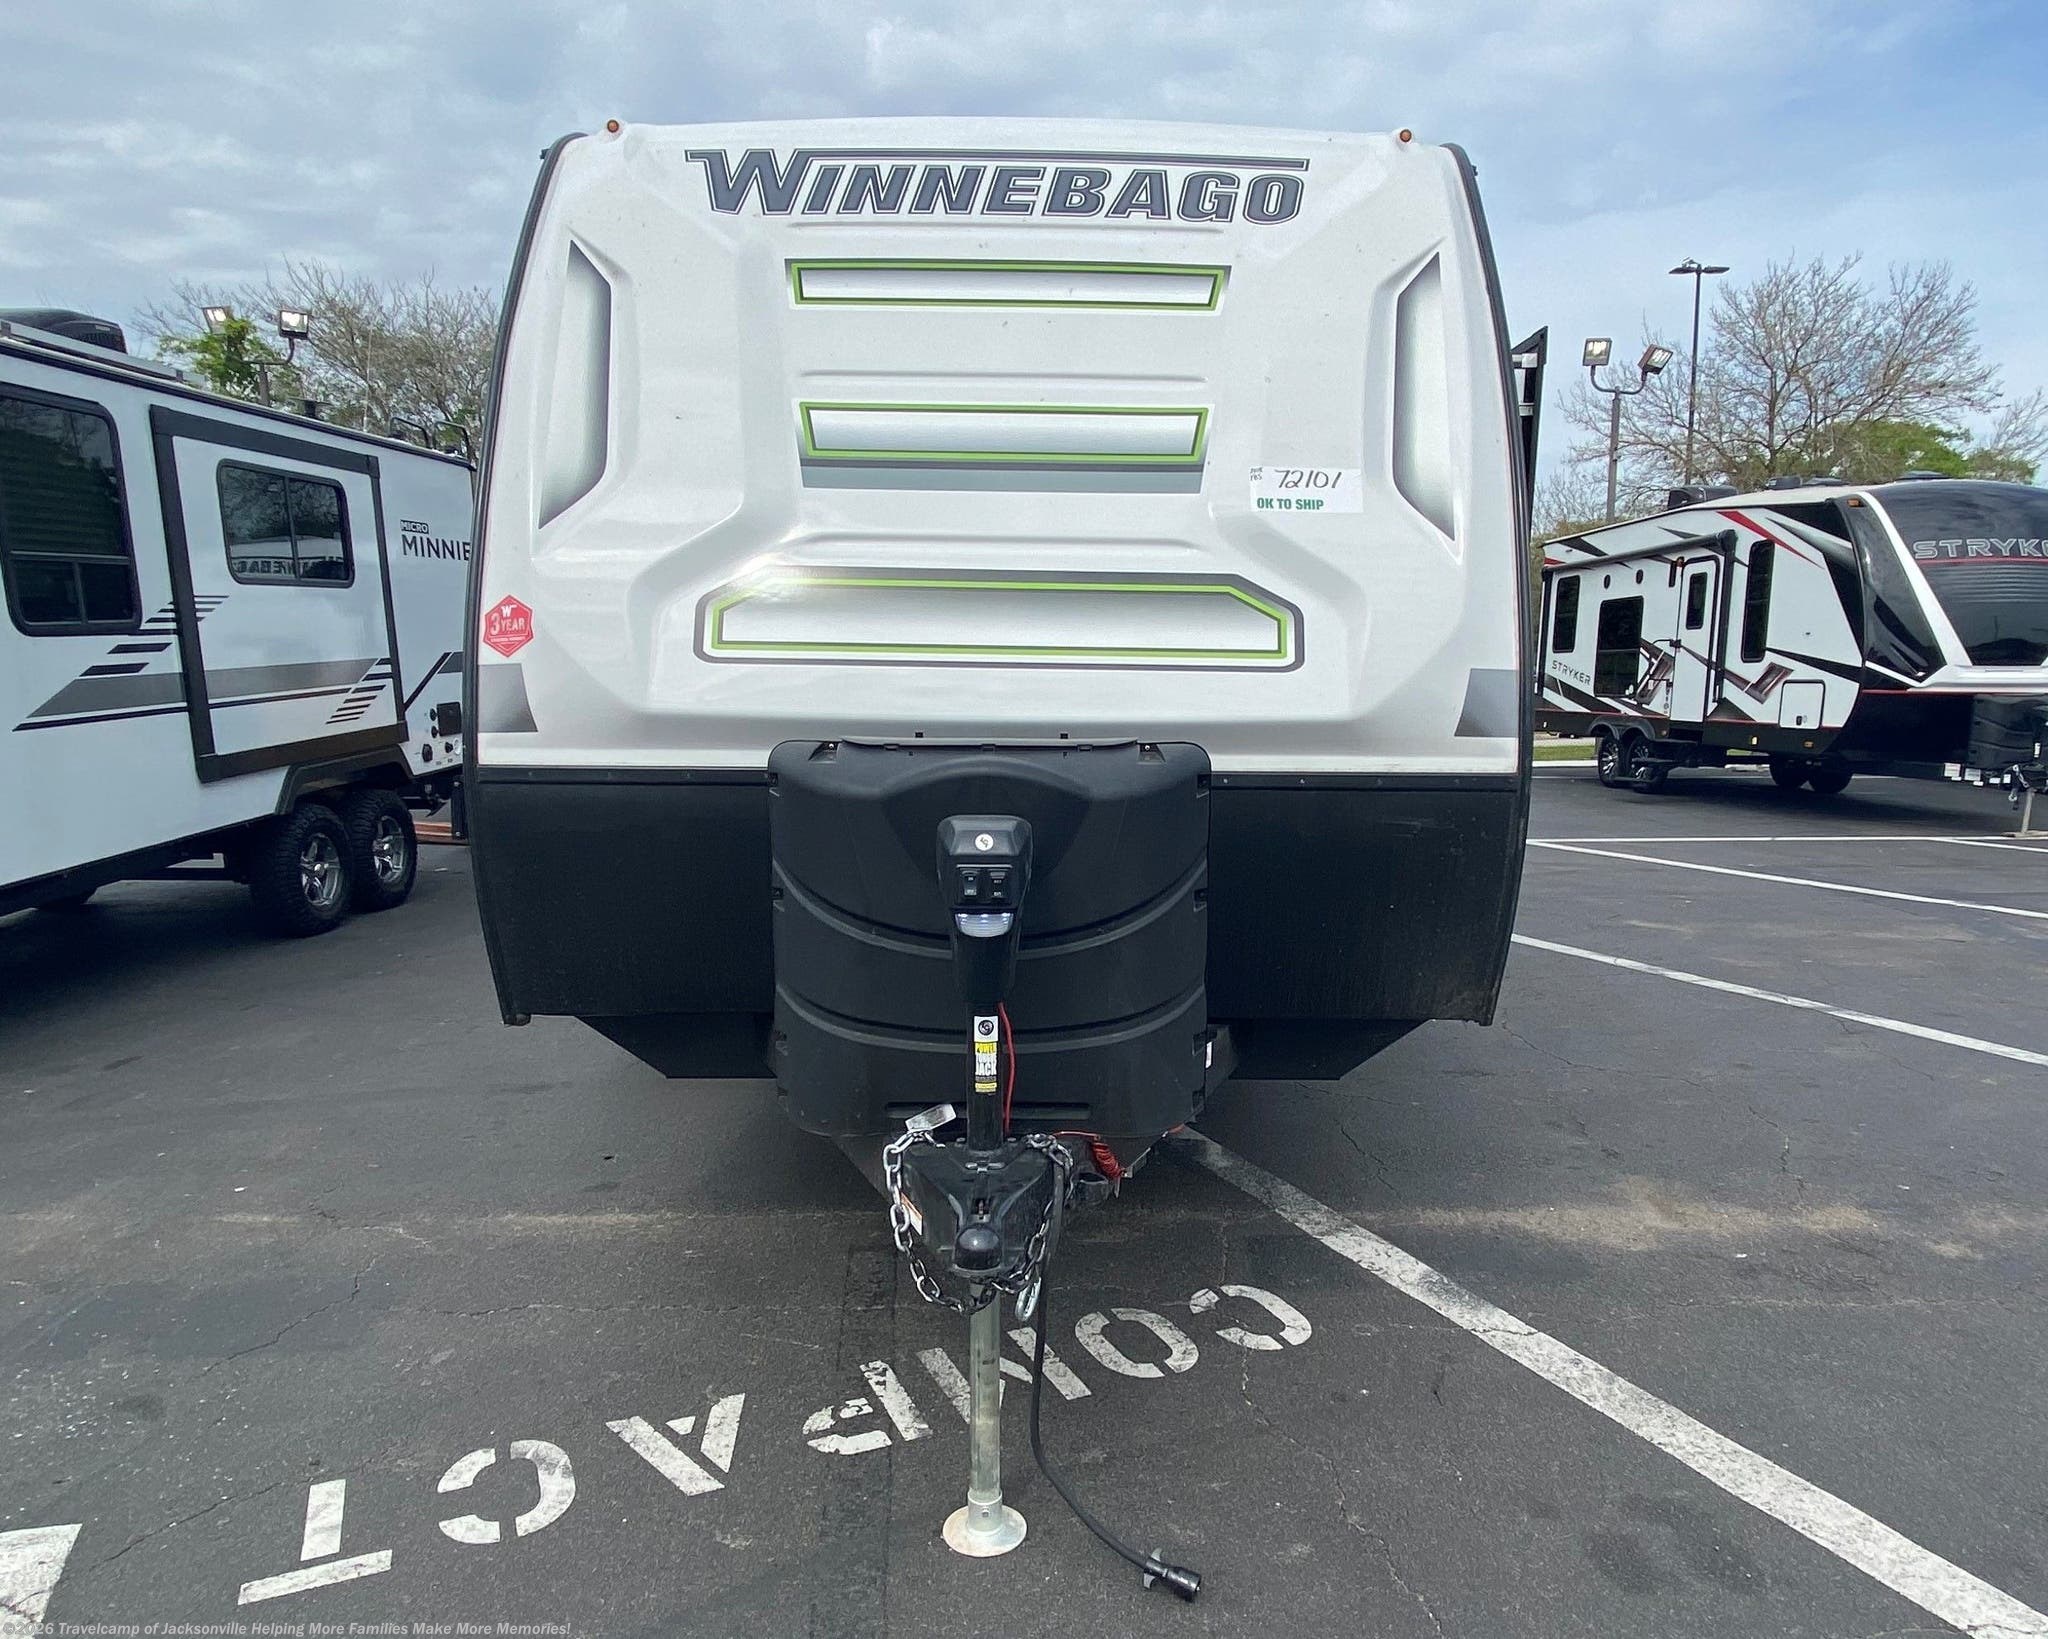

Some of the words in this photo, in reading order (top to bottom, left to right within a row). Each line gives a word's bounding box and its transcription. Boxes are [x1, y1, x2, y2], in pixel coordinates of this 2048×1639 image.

[685, 148, 1309, 226] WINNEBAGO
[1274, 468, 1342, 489] 72101
[1256, 497, 1274, 509] OK
[1276, 498, 1292, 510] TO
[1295, 498, 1324, 510] SHIP
[401, 520, 429, 534] MICRO
[401, 534, 471, 561] MINNIE
[489, 612, 501, 636] 3
[501, 617, 526, 633] YEAR
[1551, 660, 1591, 685] STRYKER
